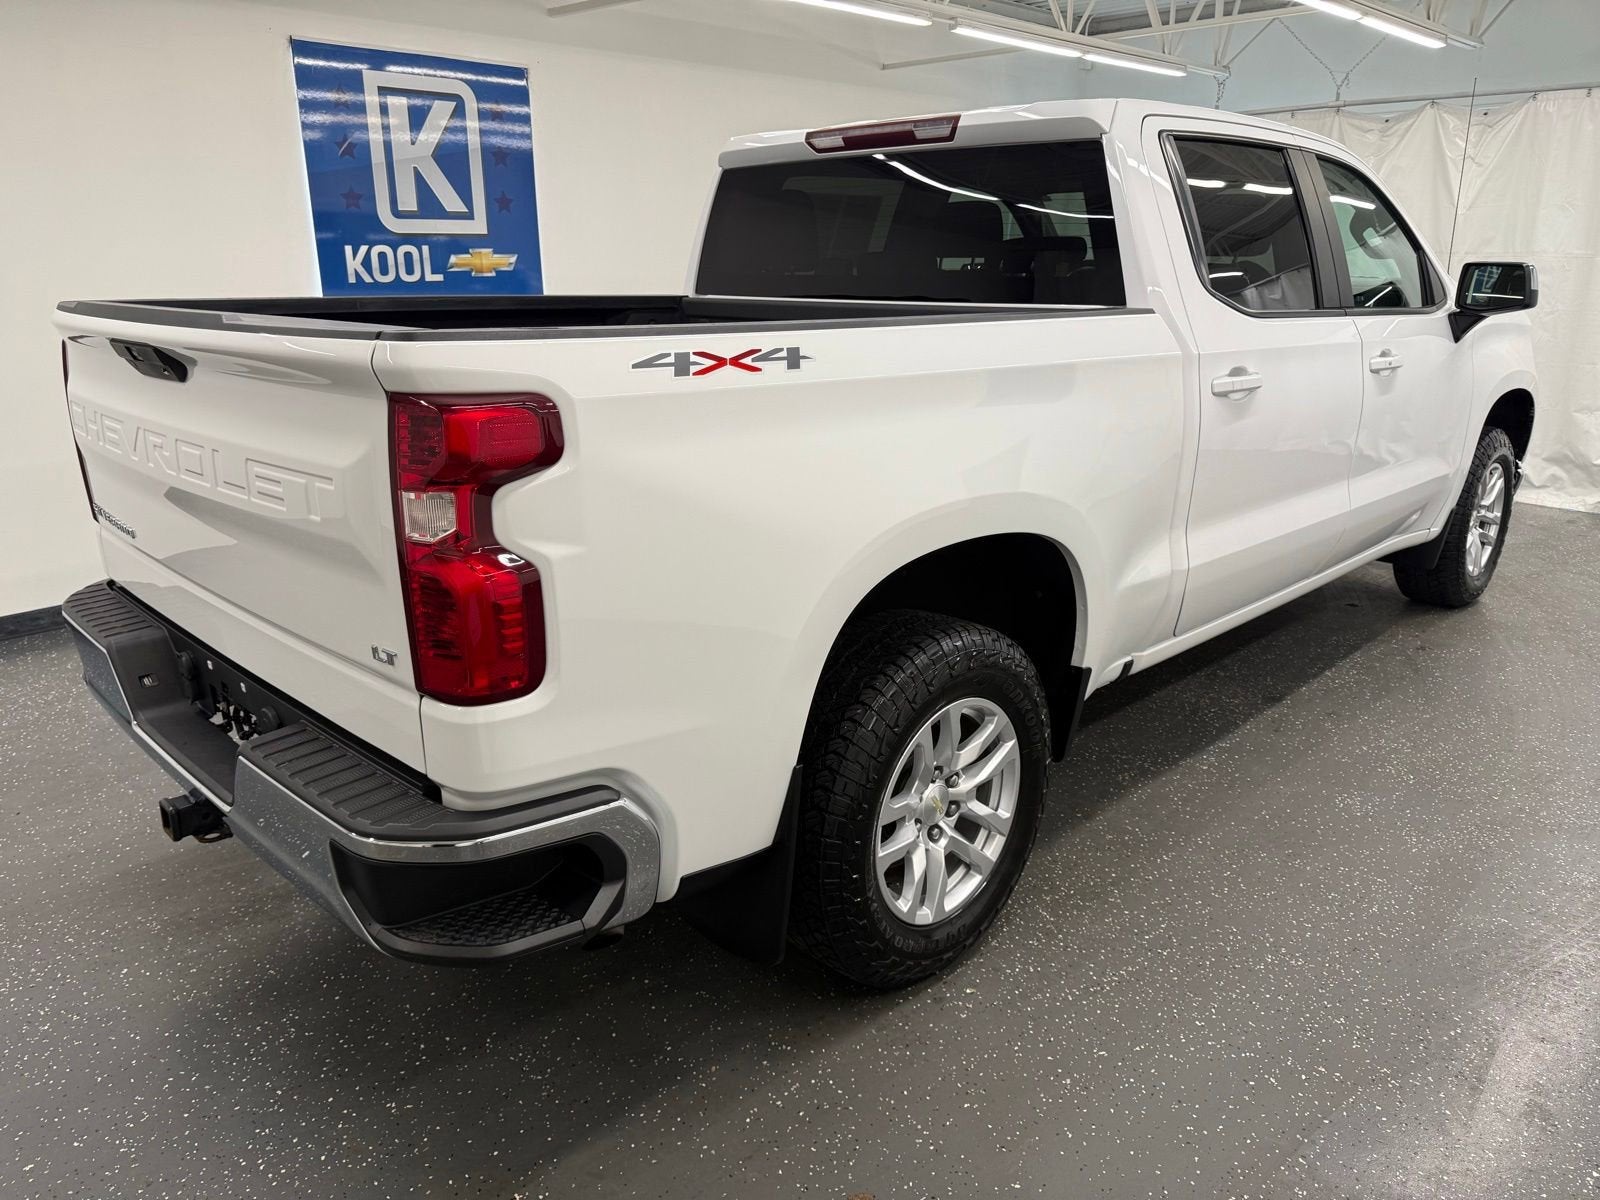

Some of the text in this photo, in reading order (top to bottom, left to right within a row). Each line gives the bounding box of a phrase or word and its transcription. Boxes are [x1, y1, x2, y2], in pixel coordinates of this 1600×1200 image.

[386, 95, 469, 213] K
[344, 244, 444, 283] KOOL
[70, 400, 335, 522] CHEVROLET
[371, 644, 398, 666] LT
